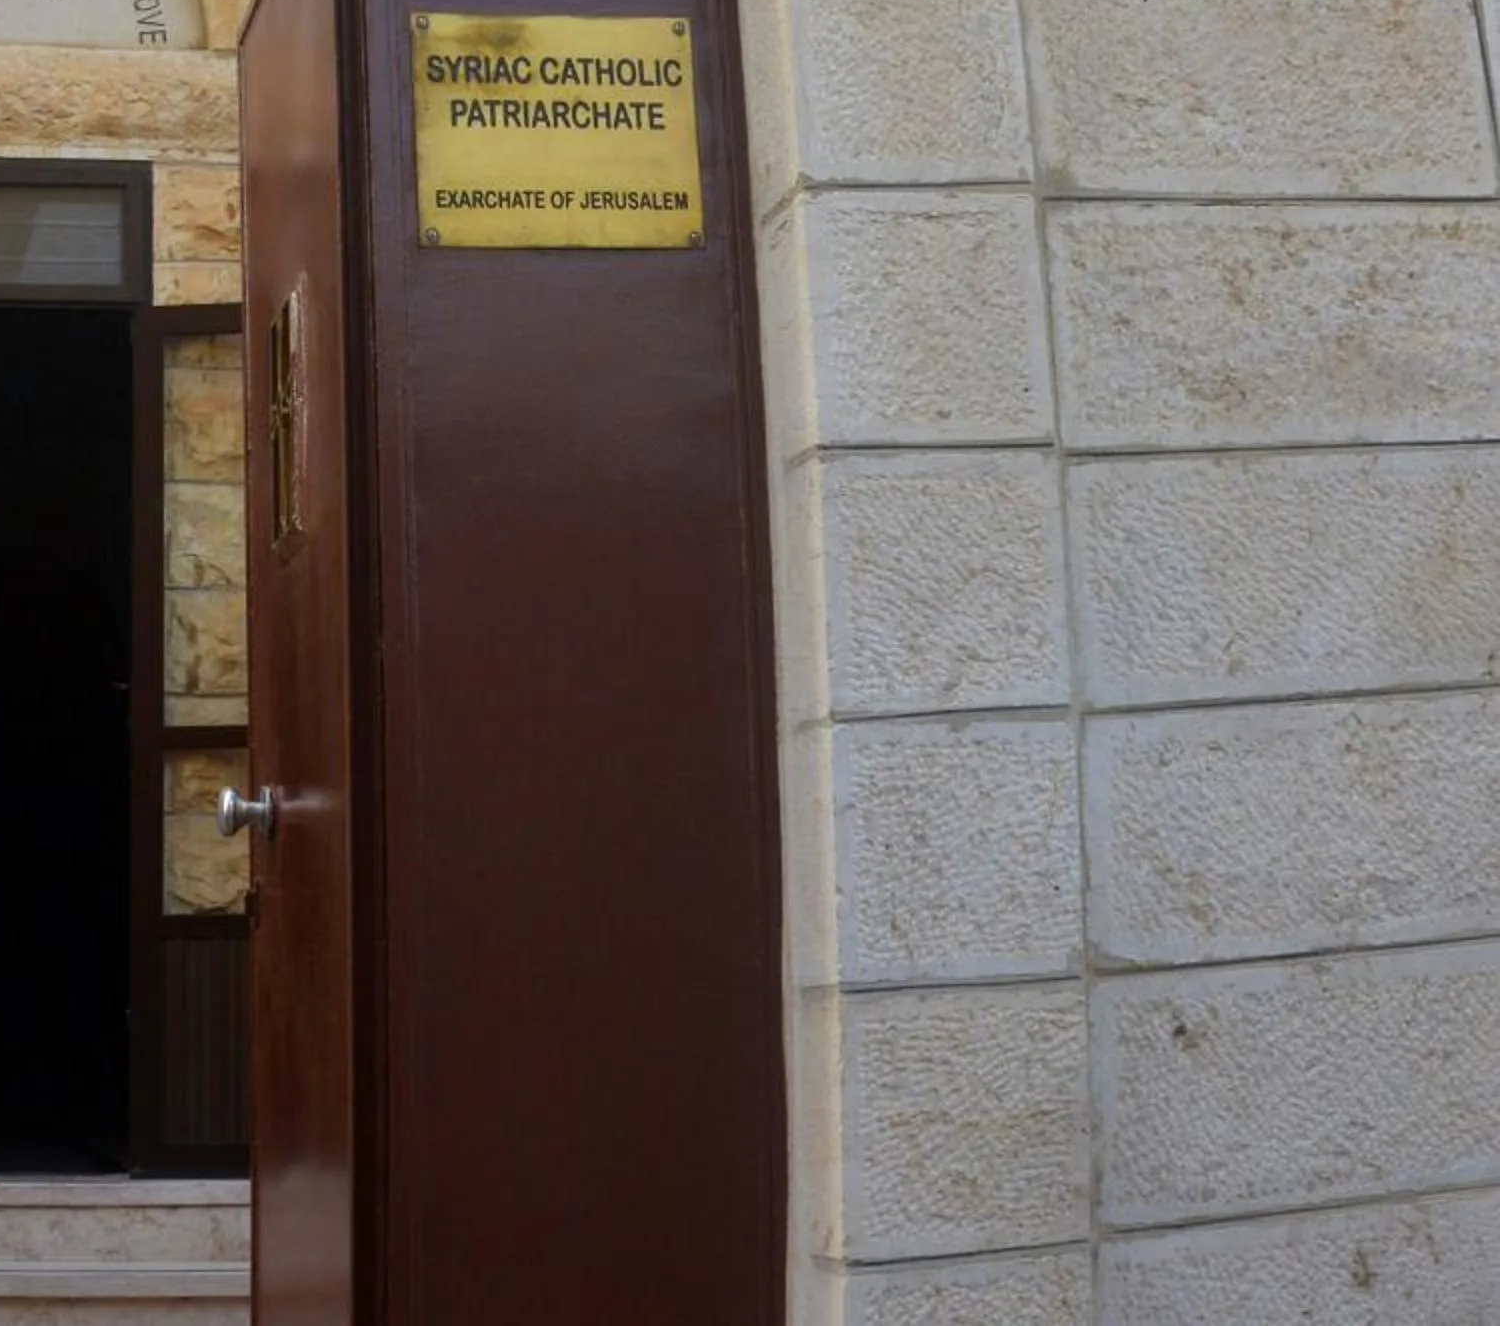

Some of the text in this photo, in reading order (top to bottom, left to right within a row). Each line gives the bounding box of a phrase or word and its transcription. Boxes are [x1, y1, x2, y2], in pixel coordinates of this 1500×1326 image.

[427, 55, 683, 87] SYRIAC CATHOLIC
[451, 99, 665, 131] PATRIARCHATE
[436, 189, 689, 211] EXARCHATE OF JERUSALEM
